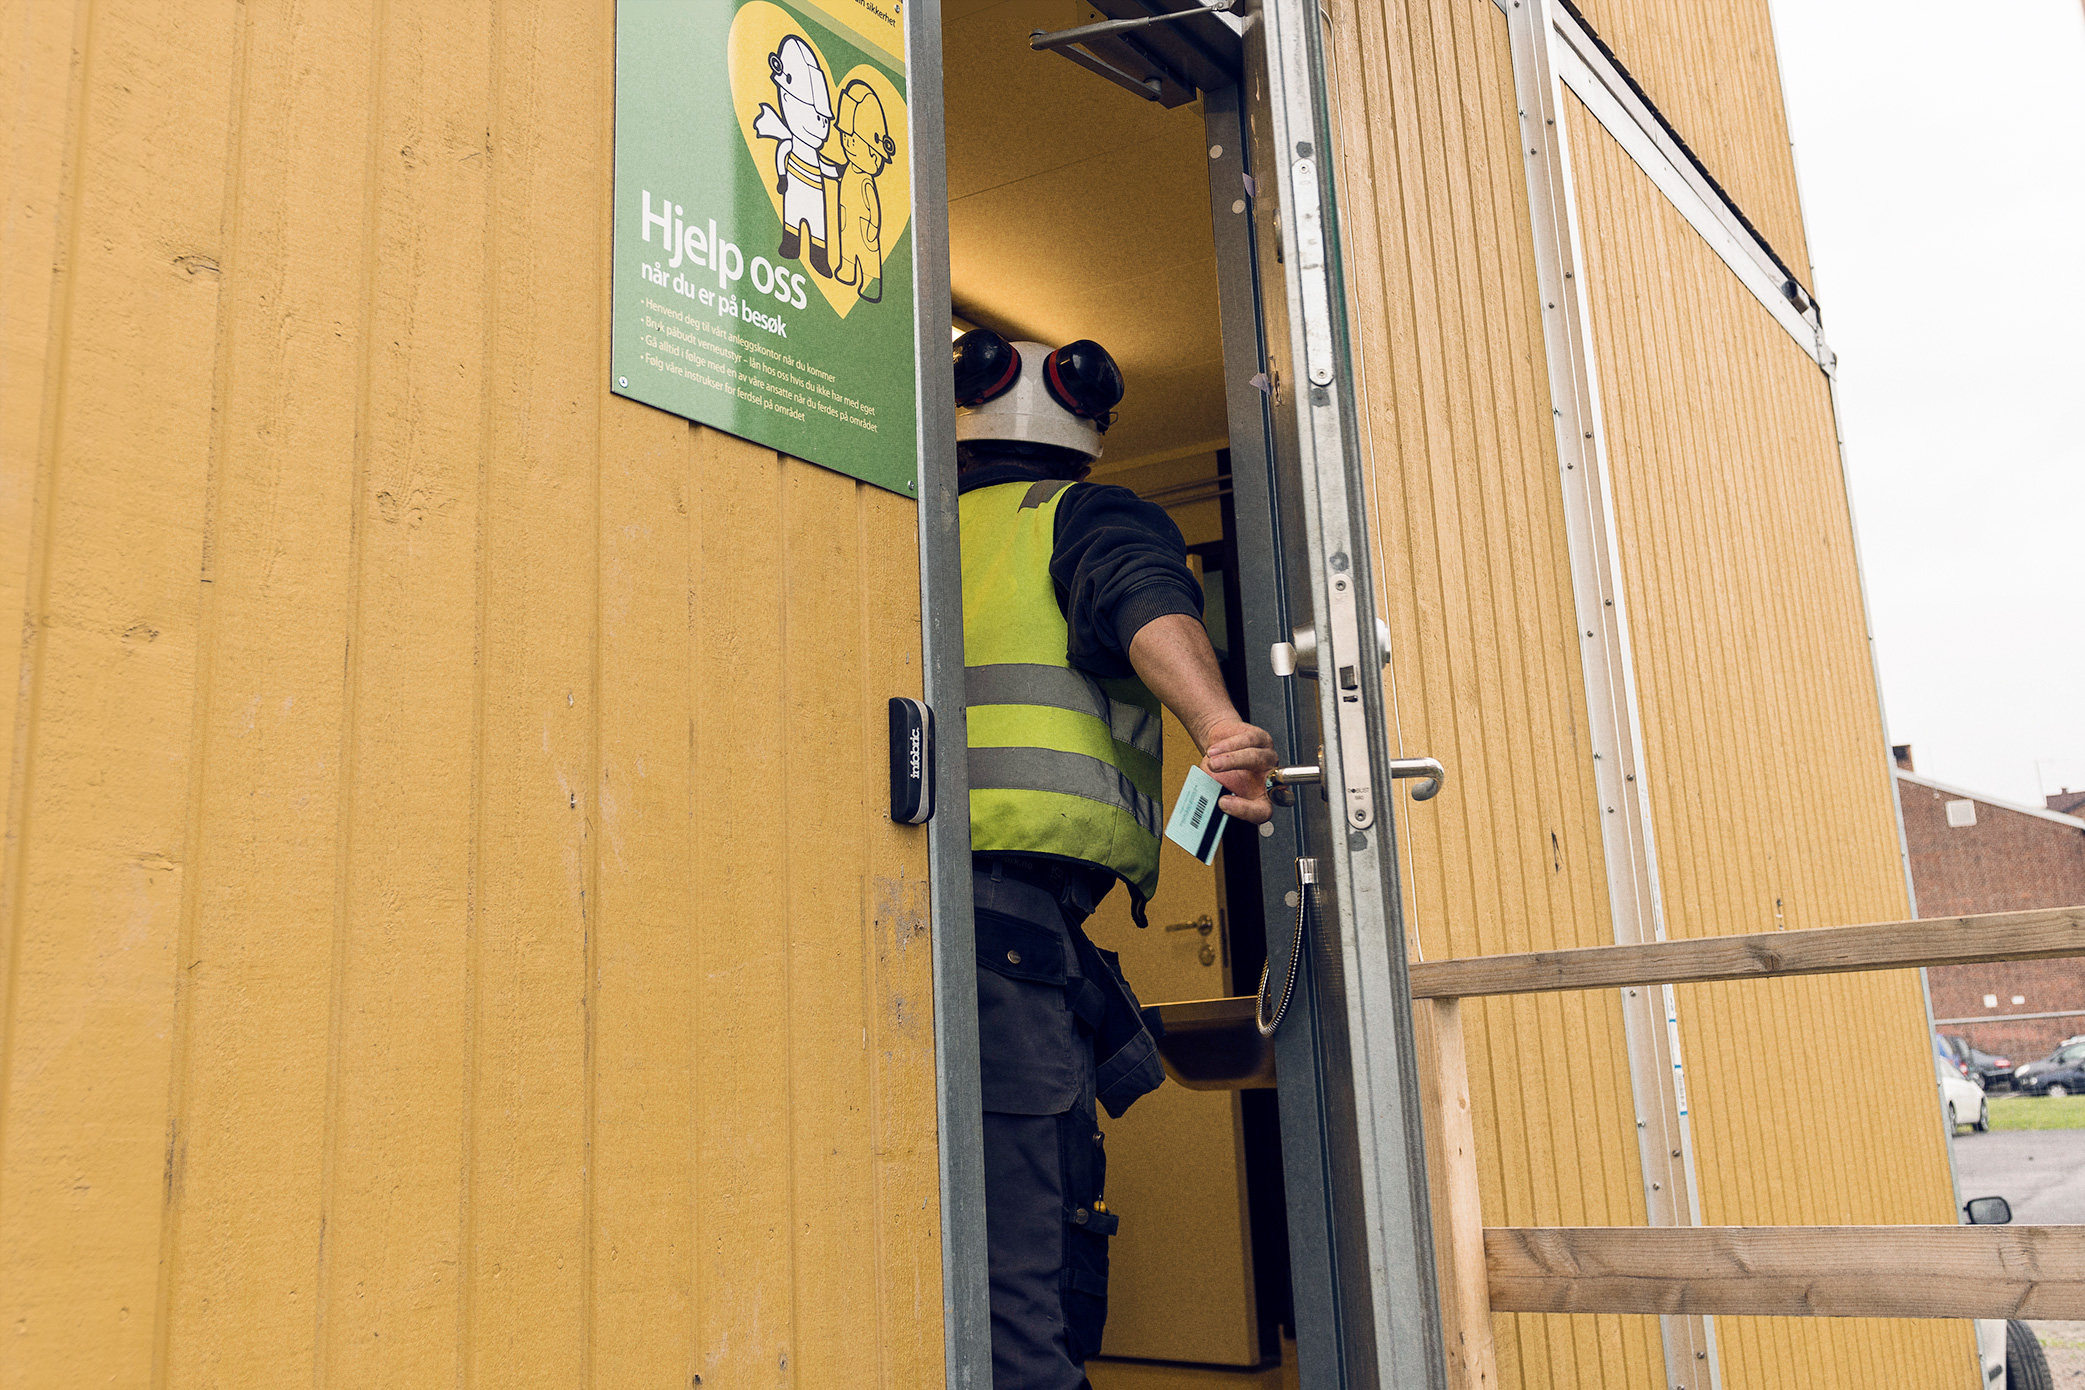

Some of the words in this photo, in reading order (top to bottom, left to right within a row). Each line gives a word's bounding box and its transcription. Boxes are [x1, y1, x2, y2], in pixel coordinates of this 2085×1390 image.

[866, 2, 896, 28] sikkerhet
[642, 190, 744, 289] Hjelp
[750, 256, 807, 310] oss
[642, 262, 670, 287] når
[673, 273, 695, 299] du
[699, 287, 715, 307] er
[718, 294, 738, 317] på
[742, 299, 787, 338] besøk
[645, 297, 683, 321] Henvend
[684, 314, 701, 331] deg
[702, 321, 710, 332] til
[711, 326, 727, 339] vårt
[728, 333, 782, 361] anleggskontor
[783, 355, 794, 367] når
[795, 360, 806, 371] du
[806, 362, 835, 383] kommer
[645, 316, 665, 333] Bruk
[666, 325, 696, 346] påbudt
[697, 338, 742, 363] verneutstyr
[749, 357, 761, 371] lån
[762, 362, 776, 377] hos
[777, 370, 790, 382] oss
[790, 373, 804, 388] hvis
[805, 380, 815, 391] du
[816, 384, 830, 398] ikke
[831, 389, 843, 402] har
[843, 397, 859, 409] med
[860, 403, 875, 416] eget
[645, 334, 658, 348] Gå
[658, 341, 680, 356] alltid
[685, 349, 706, 367] følge
[707, 360, 726, 374] med
[726, 367, 737, 378] en
[737, 372, 748, 382] av
[748, 376, 764, 389] våre
[765, 382, 793, 400] ansatte
[793, 393, 805, 404] når
[806, 397, 817, 409] du
[817, 400, 839, 418] ferdes
[840, 411, 848, 421] på
[849, 415, 877, 433] området
[645, 353, 664, 371] Følg
[665, 362, 683, 376] våre
[684, 367, 723, 391] instrukser
[724, 382, 736, 395] for
[736, 387, 762, 406] ferdsel
[763, 399, 773, 410] på
[774, 401, 805, 422] området
